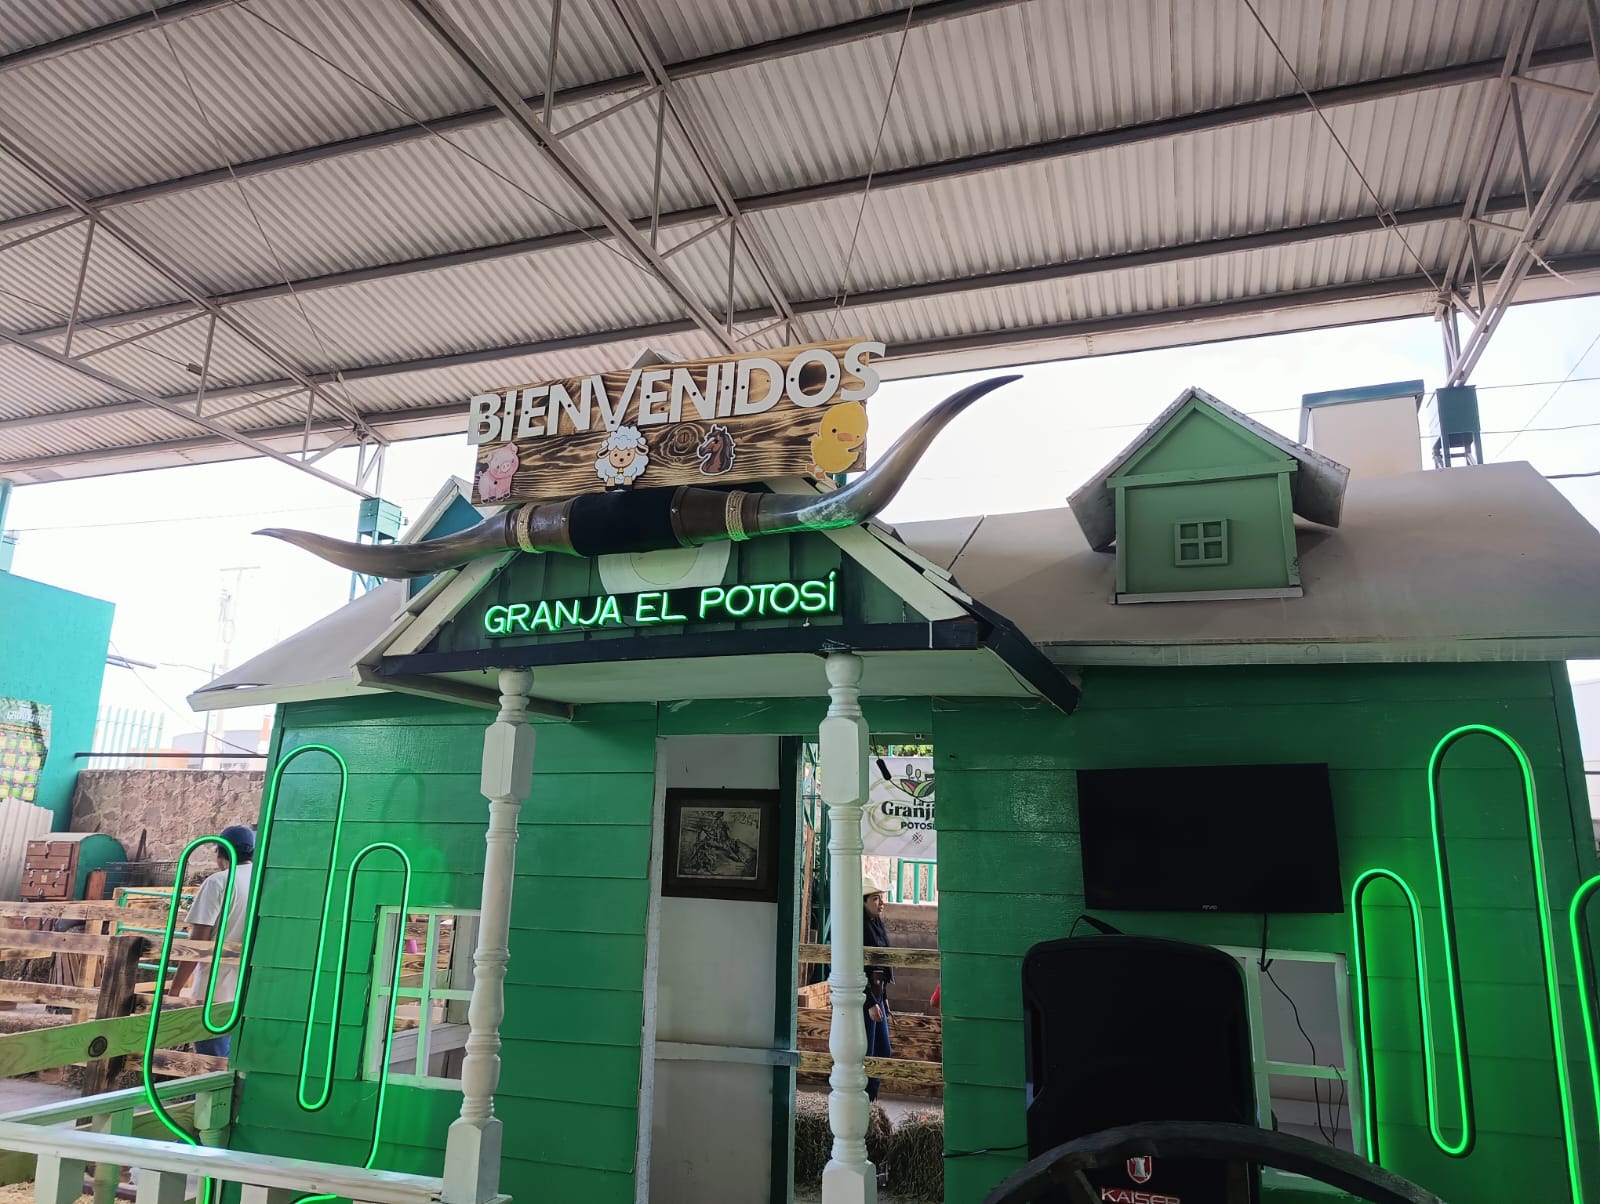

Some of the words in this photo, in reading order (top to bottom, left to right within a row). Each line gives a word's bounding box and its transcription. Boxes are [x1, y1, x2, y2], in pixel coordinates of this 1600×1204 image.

[467, 341, 886, 446] BIENVENIDOS
[484, 597, 622, 633] GRANJA
[635, 592, 687, 623] EL
